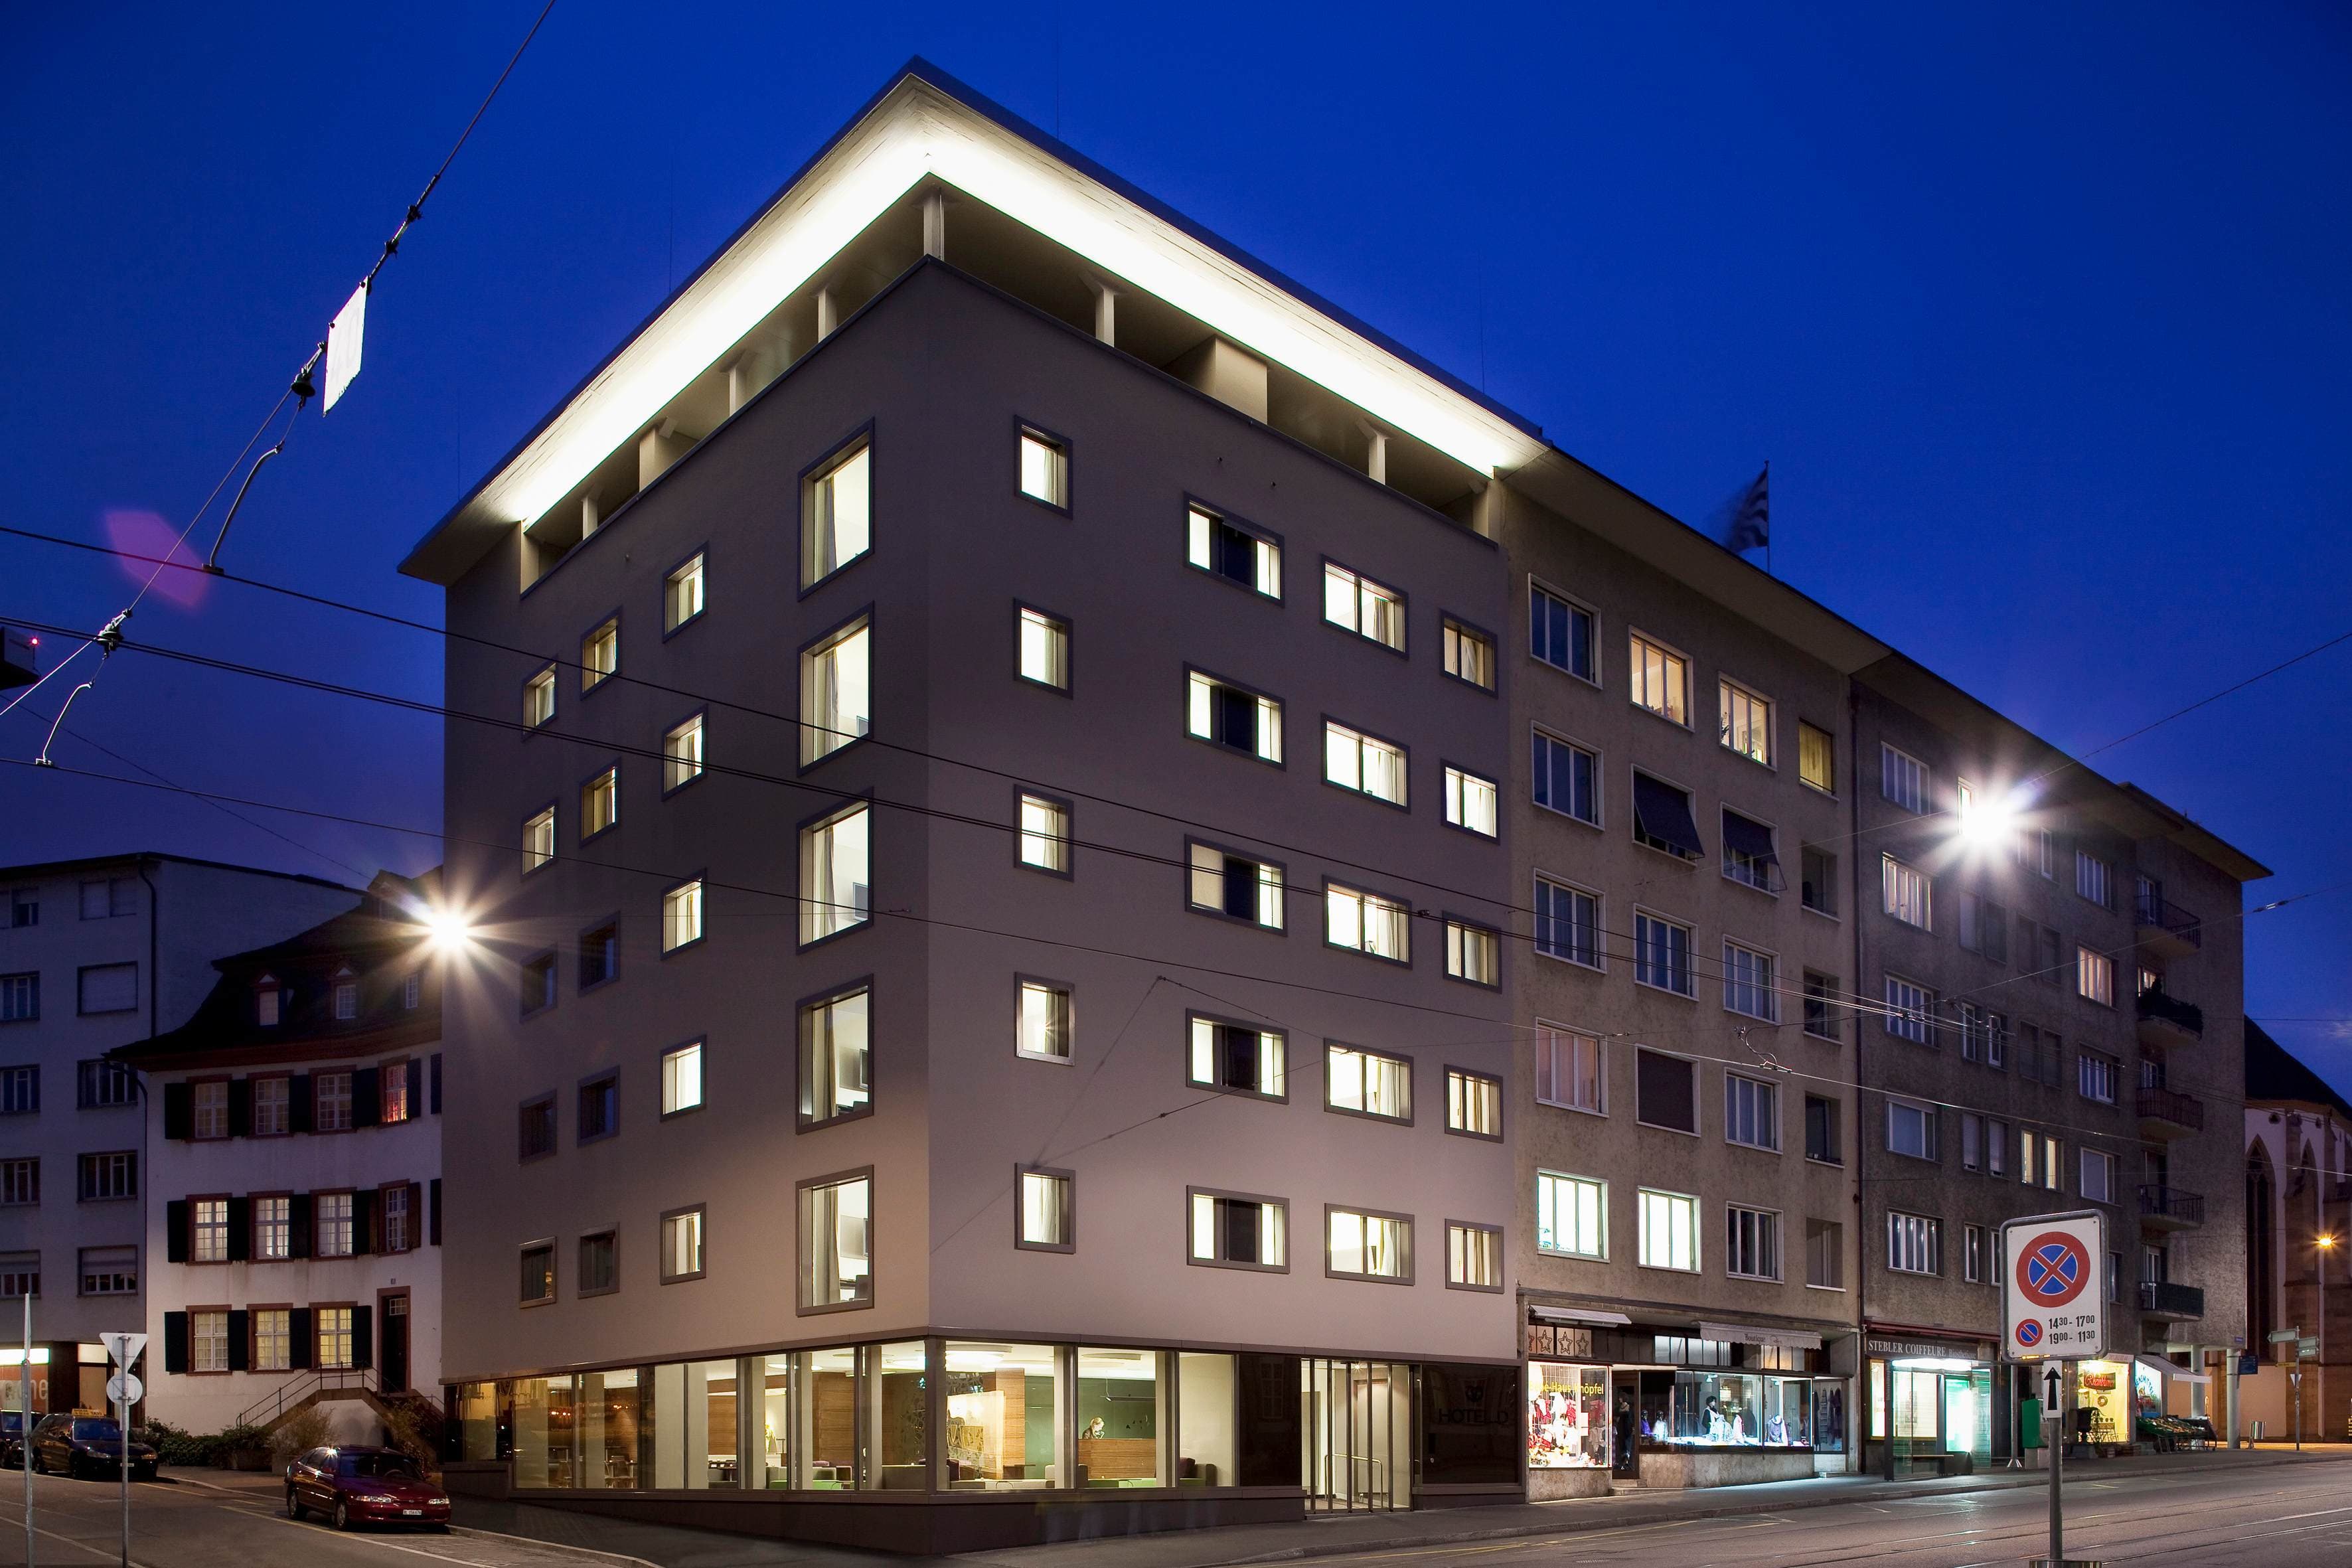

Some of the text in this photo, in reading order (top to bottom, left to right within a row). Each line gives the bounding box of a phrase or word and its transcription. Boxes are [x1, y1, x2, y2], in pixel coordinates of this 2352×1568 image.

[2075, 1315, 2095, 1328] 1700
[2049, 1333, 2068, 1344] 1900
[2078, 1330, 2095, 1343] 1130
[1869, 1340, 1903, 1354] STEBLER
[1905, 1343, 1946, 1357] COIFFEURE
[1574, 1383, 1604, 1397] Knöpfel
[1439, 1407, 1493, 1425] HOTEL
